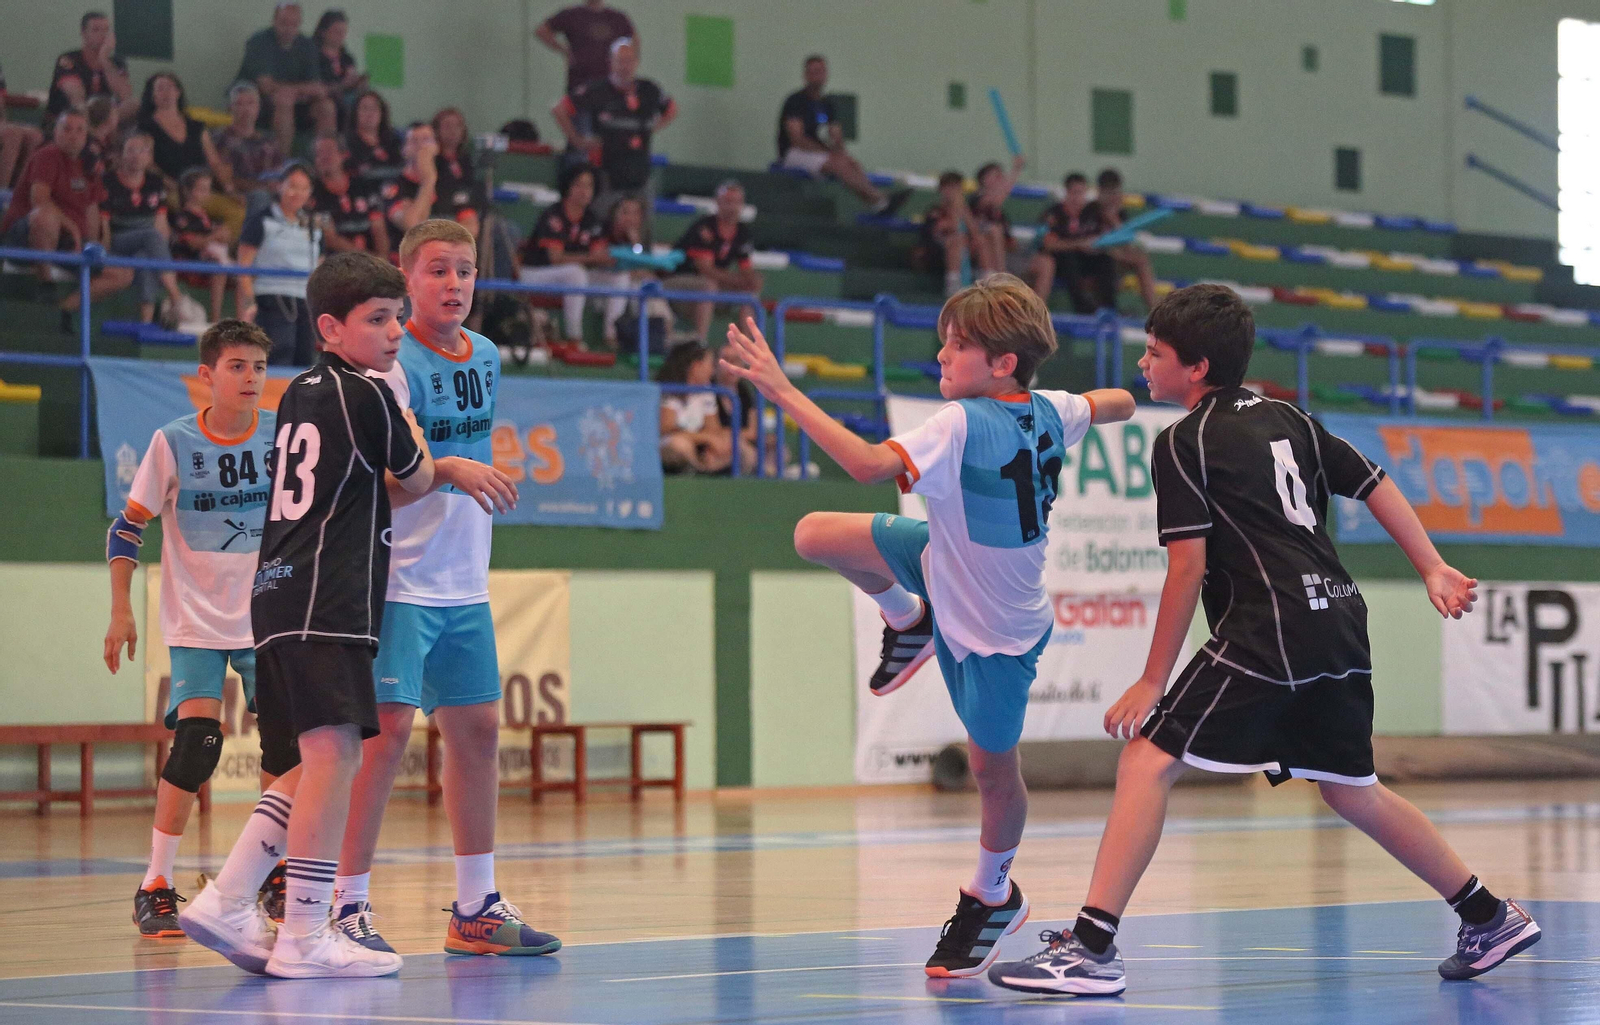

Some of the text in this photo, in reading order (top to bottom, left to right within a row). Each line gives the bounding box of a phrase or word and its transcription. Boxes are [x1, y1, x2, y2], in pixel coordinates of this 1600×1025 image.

[453, 368, 484, 412] 90
[218, 451, 258, 488] 84
[270, 422, 322, 521] 13
[1058, 424, 1162, 498] AB
[1269, 438, 1317, 534] 4
[220, 489, 268, 508] cajam
[1323, 577, 1358, 598] COLUM
[502, 672, 565, 728] OS
